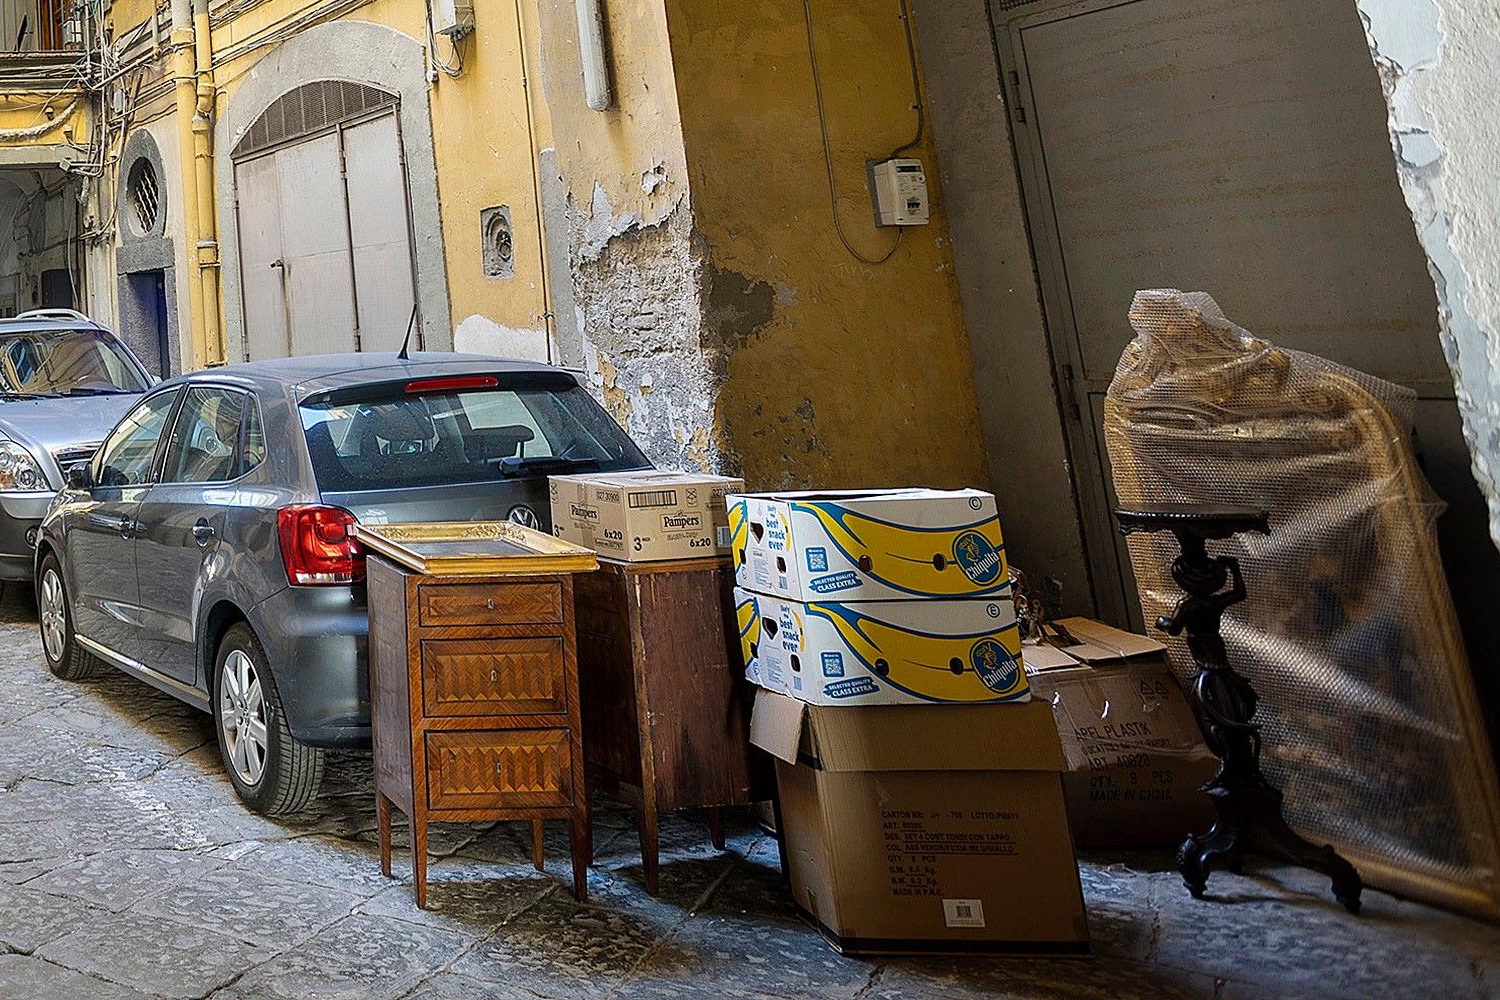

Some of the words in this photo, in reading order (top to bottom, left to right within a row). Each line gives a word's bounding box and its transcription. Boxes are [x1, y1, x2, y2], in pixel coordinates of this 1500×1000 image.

[571, 504, 597, 519] Pampers
[664, 515, 699, 529] Pampers
[766, 517, 779, 529] best
[554, 524, 560, 537] 3
[604, 529, 623, 540] 6x20
[769, 530, 785, 540] snack
[634, 537, 642, 551] 3
[689, 538, 711, 547] 6x20
[769, 540, 783, 550] ever
[965, 551, 1000, 580] Chiquita
[813, 576, 835, 585] SELECTED
[835, 573, 854, 581] QUALITY
[817, 582, 836, 592] CLASS
[836, 579, 856, 588] EXTRA
[779, 617, 793, 629] best
[782, 630, 800, 642] snack
[782, 641, 798, 653] ever
[982, 658, 1018, 689] Chiquita
[828, 682, 851, 690] SELECTED
[851, 679, 871, 687] QUALITY
[832, 687, 852, 697] CLASS
[852, 684, 873, 693] EXTRA
[1130, 772, 1137, 784] 8
[1152, 770, 1173, 783] PCS
[882, 811, 910, 819] CARTON
